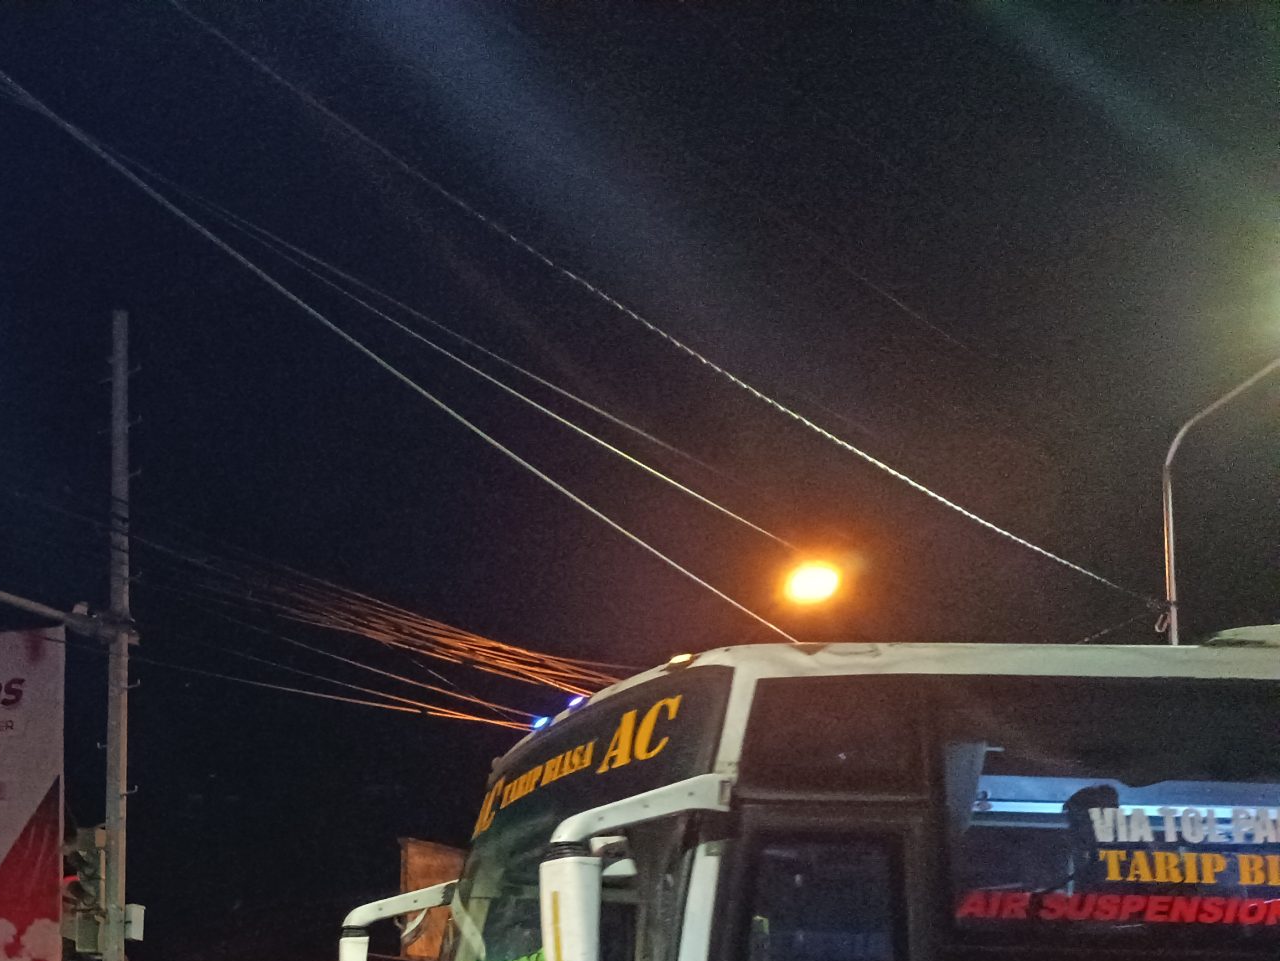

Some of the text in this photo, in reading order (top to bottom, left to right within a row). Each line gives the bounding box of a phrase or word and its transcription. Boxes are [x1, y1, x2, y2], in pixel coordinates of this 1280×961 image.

[596, 694, 683, 774] AC
[1088, 806, 1154, 842] VIA
[1157, 806, 1230, 843] TOL
[1098, 850, 1228, 885] TARIP
[956, 891, 1031, 920] AIR
